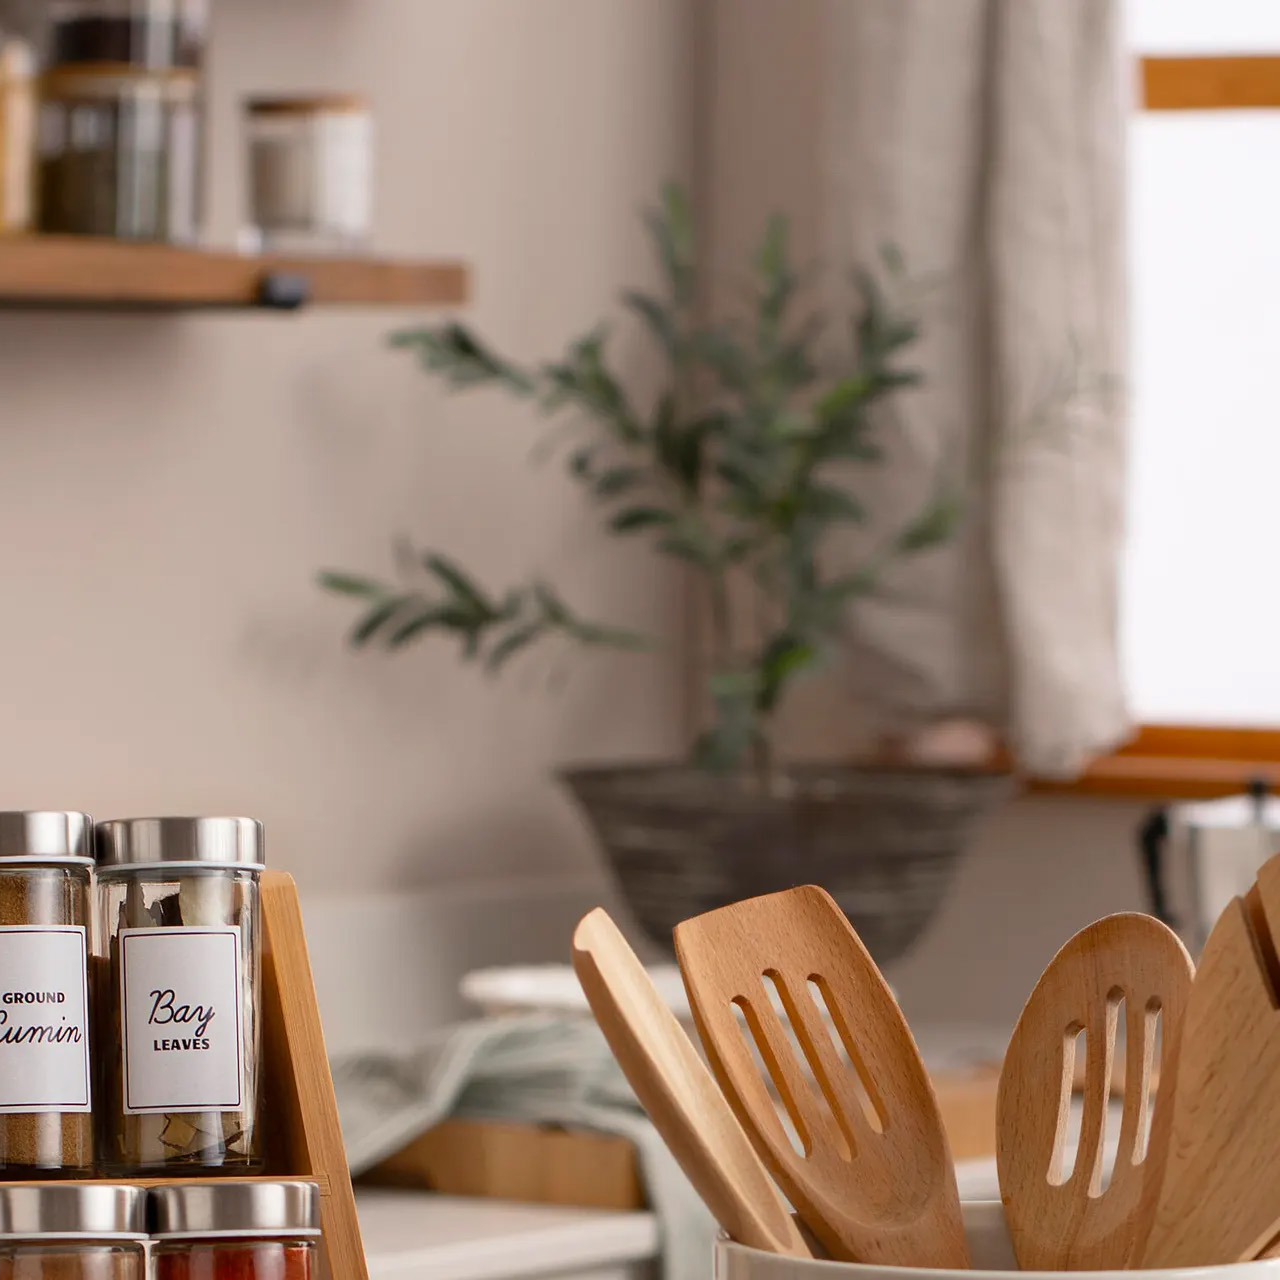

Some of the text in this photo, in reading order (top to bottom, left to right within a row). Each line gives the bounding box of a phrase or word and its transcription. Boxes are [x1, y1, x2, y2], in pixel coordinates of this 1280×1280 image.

[2, 991, 65, 1005] GROUND
[148, 989, 215, 1037] Bay
[153, 1038, 210, 1051] LEAVES
